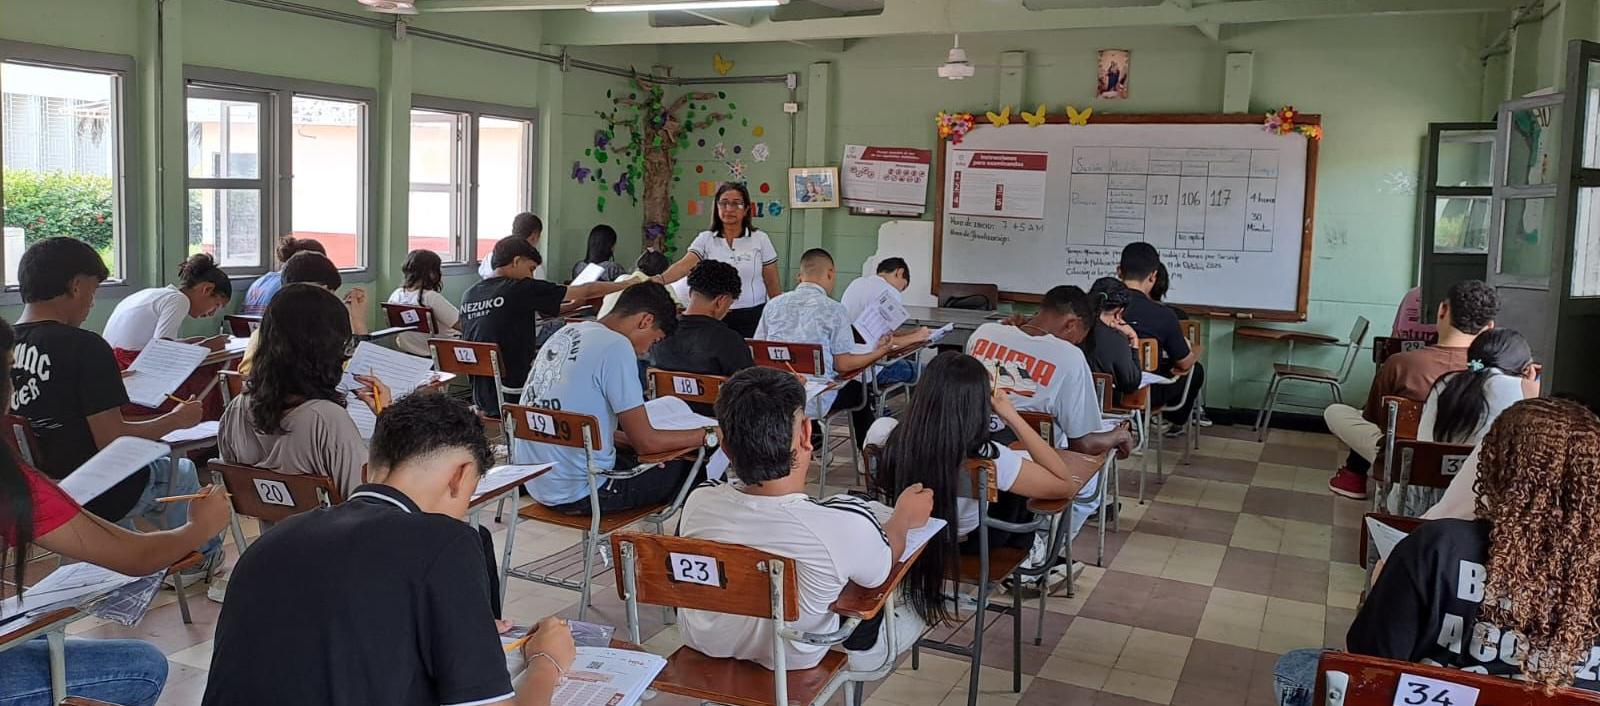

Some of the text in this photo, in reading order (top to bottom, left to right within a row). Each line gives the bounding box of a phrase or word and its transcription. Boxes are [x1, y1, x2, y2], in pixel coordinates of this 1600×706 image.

[1181, 192, 1201, 206] 106
[1209, 189, 1232, 207] 117
[460, 296, 505, 314] NEZUKO
[459, 349, 471, 361] 12
[970, 338, 1057, 388] PUMA
[681, 380, 692, 394] 18
[531, 414, 546, 432] 19
[260, 483, 283, 503] 20
[680, 559, 709, 582] 23
[1404, 681, 1454, 706] 34
